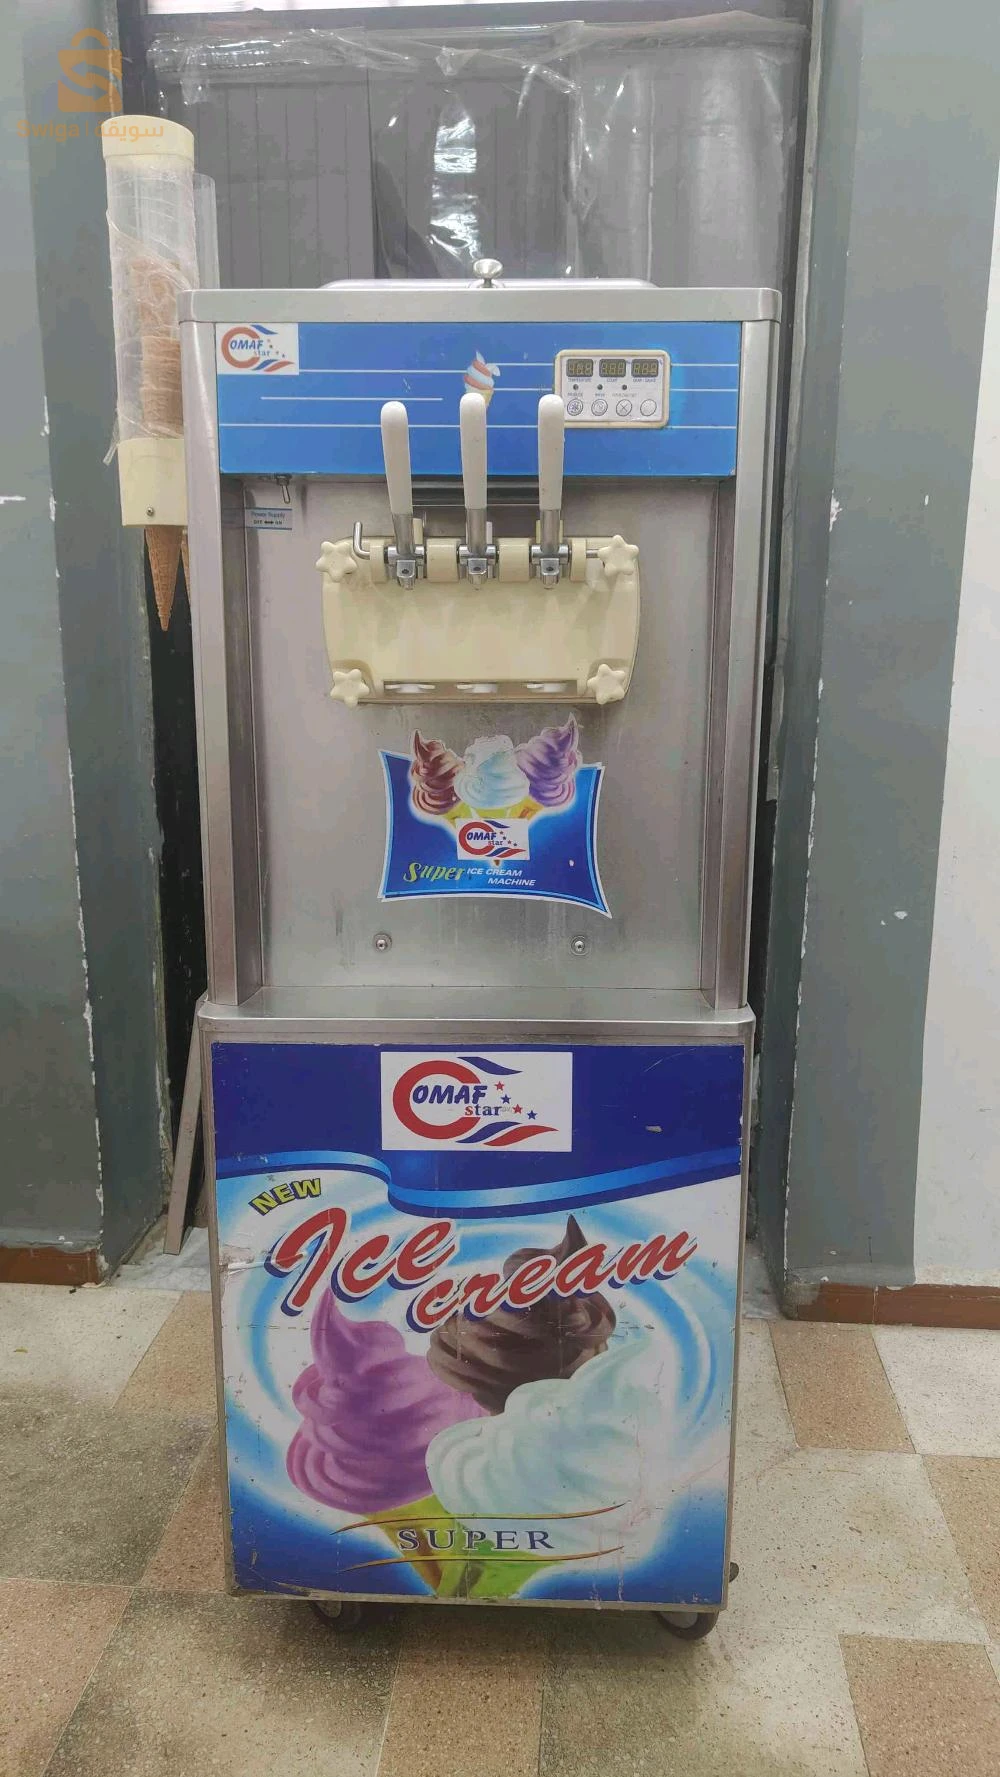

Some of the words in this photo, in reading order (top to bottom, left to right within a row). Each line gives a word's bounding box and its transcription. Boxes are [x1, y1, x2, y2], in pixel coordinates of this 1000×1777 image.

[488, 839, 504, 847] star
[403, 862, 466, 882] Super
[466, 867, 484, 876] ICE
[485, 868, 523, 878] CREAM
[487, 877, 537, 886] MACHINE
[464, 1102, 504, 1117] star
[248, 1177, 322, 1216] NEW
[264, 1206, 457, 1316] Ice
[406, 1229, 698, 1333] cream
[397, 1529, 556, 1550] SUPER
